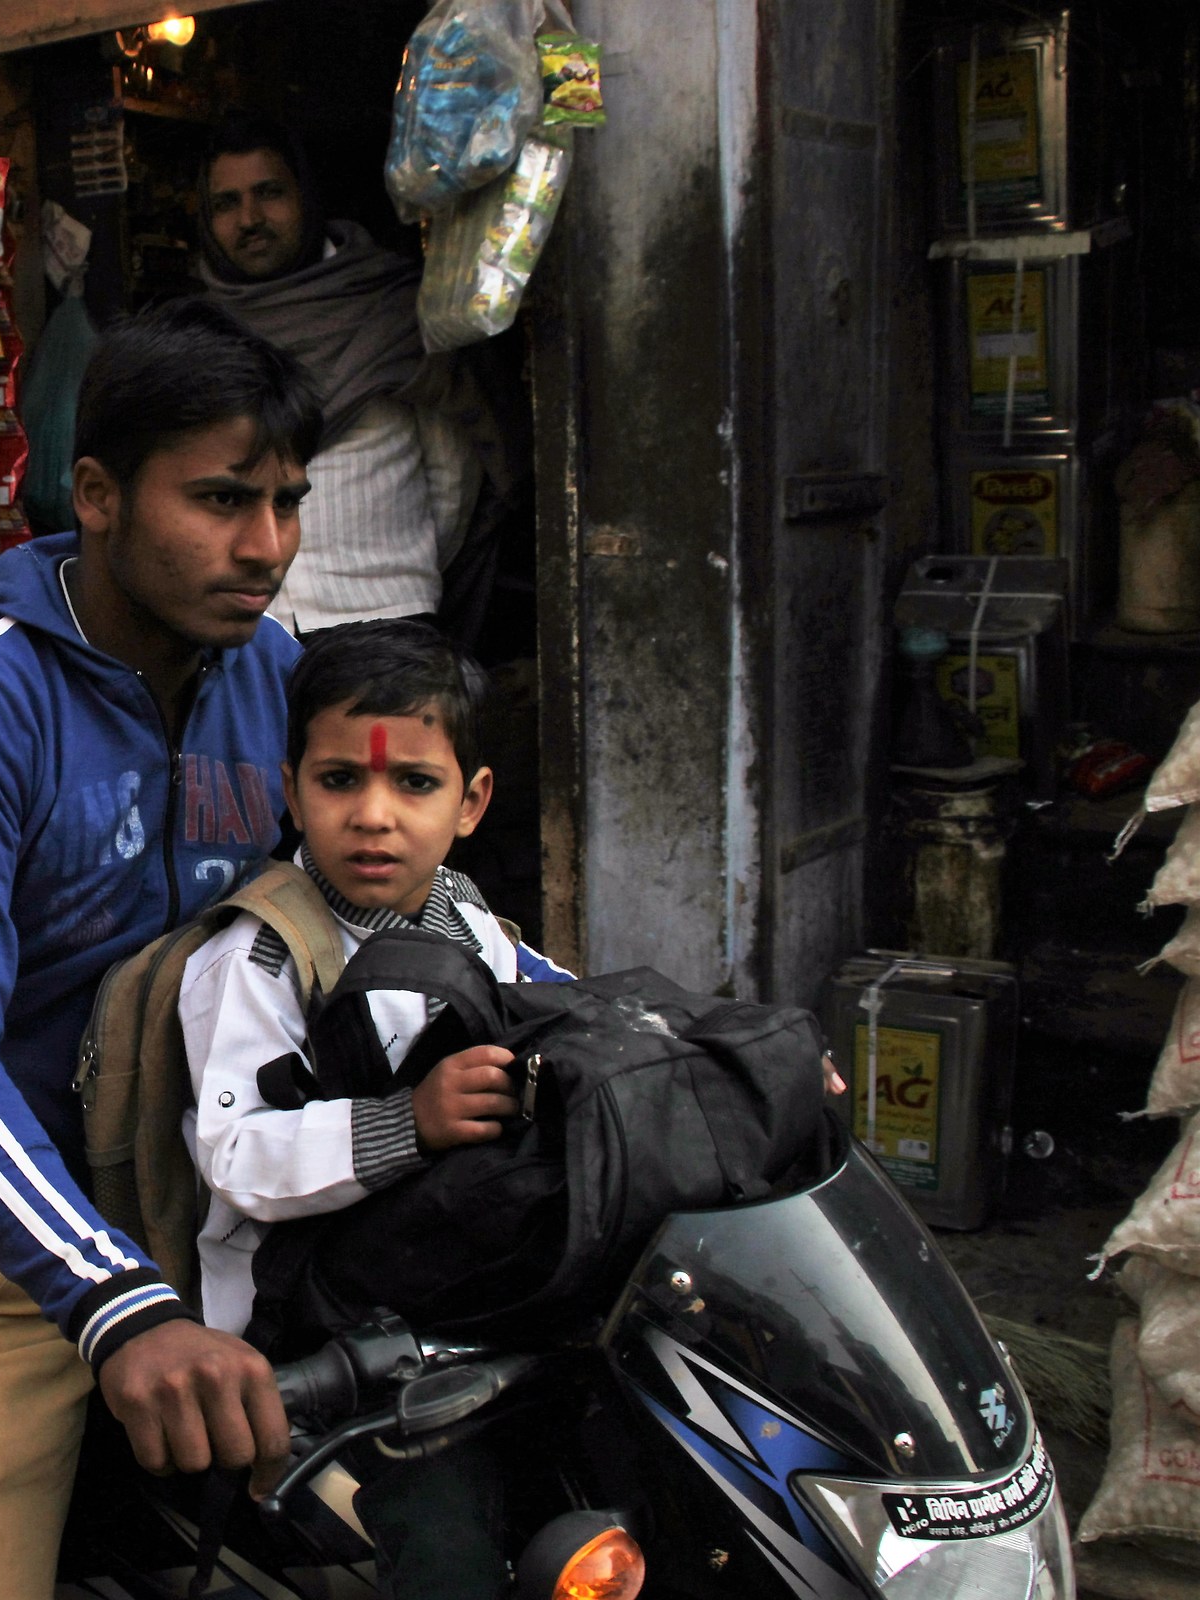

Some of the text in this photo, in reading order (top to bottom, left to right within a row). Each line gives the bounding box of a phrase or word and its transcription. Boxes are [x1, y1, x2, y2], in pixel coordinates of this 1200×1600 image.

[858, 1073, 934, 1109] AG
[925, 1497, 971, 1520] विपिन
[901, 1518, 929, 1536] Hero
